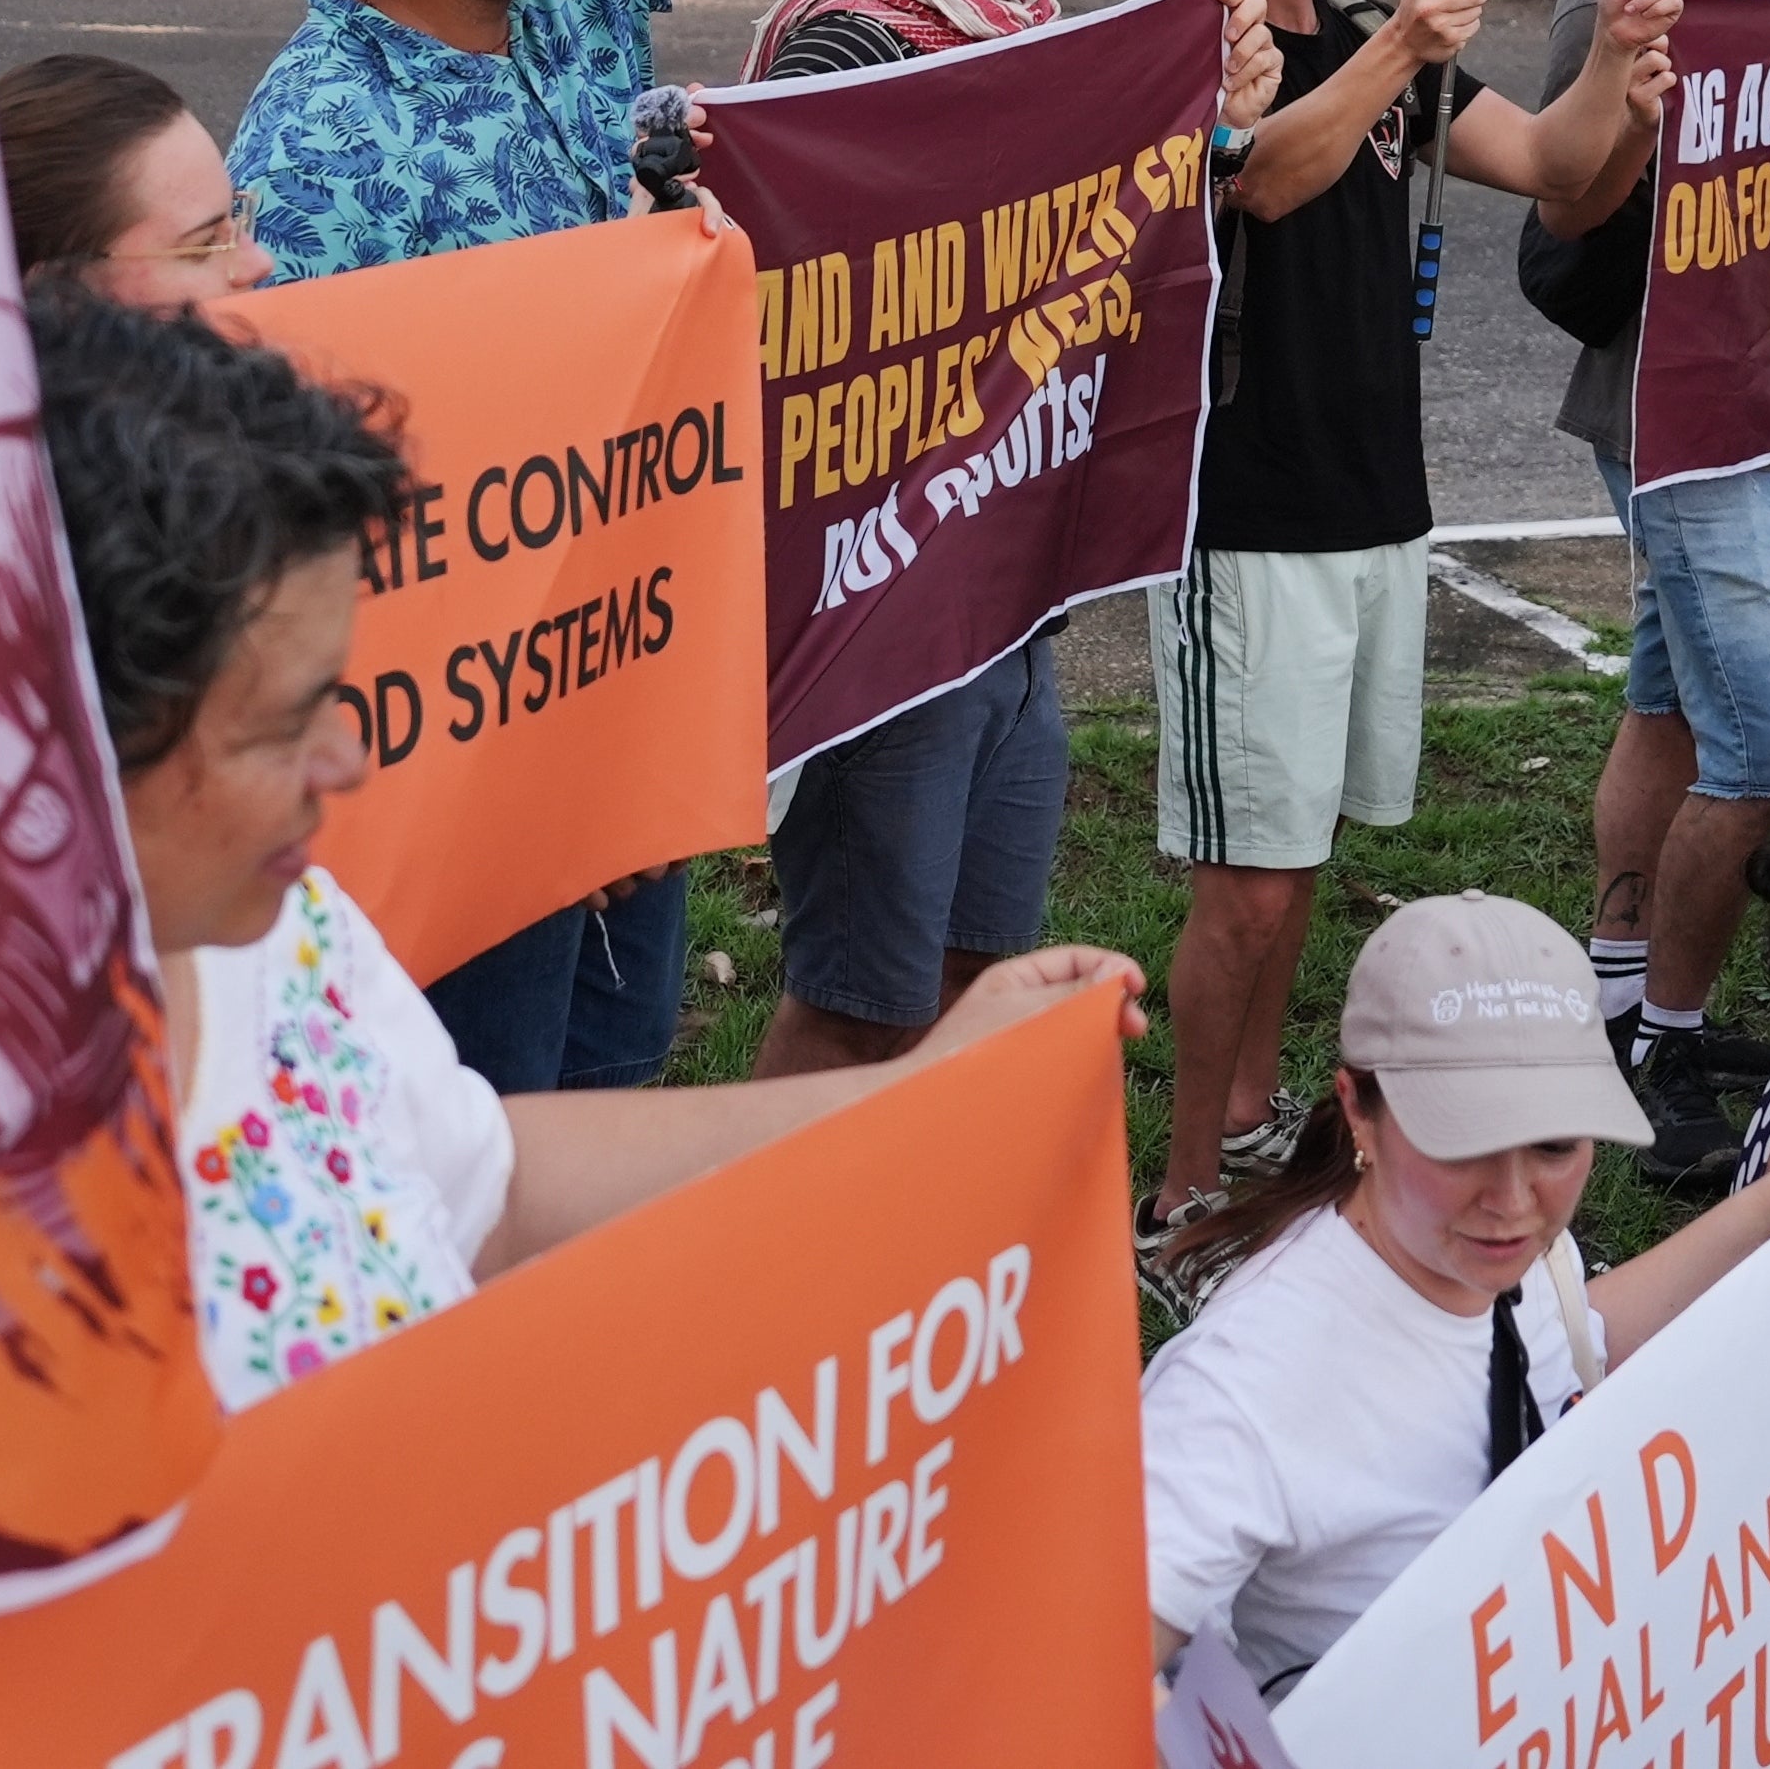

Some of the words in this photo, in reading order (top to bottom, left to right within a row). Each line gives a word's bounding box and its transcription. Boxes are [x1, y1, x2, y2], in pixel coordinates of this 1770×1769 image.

[868, 220, 966, 353] AND
[981, 164, 1137, 314] WATER
[467, 400, 744, 563] CONTROL
[810, 479, 919, 617] not
[444, 565, 674, 743] SYSTEMS
[865, 1242, 1032, 1467] FOR
[581, 1436, 955, 1769] NATURE
[1469, 1428, 1698, 1748] END
